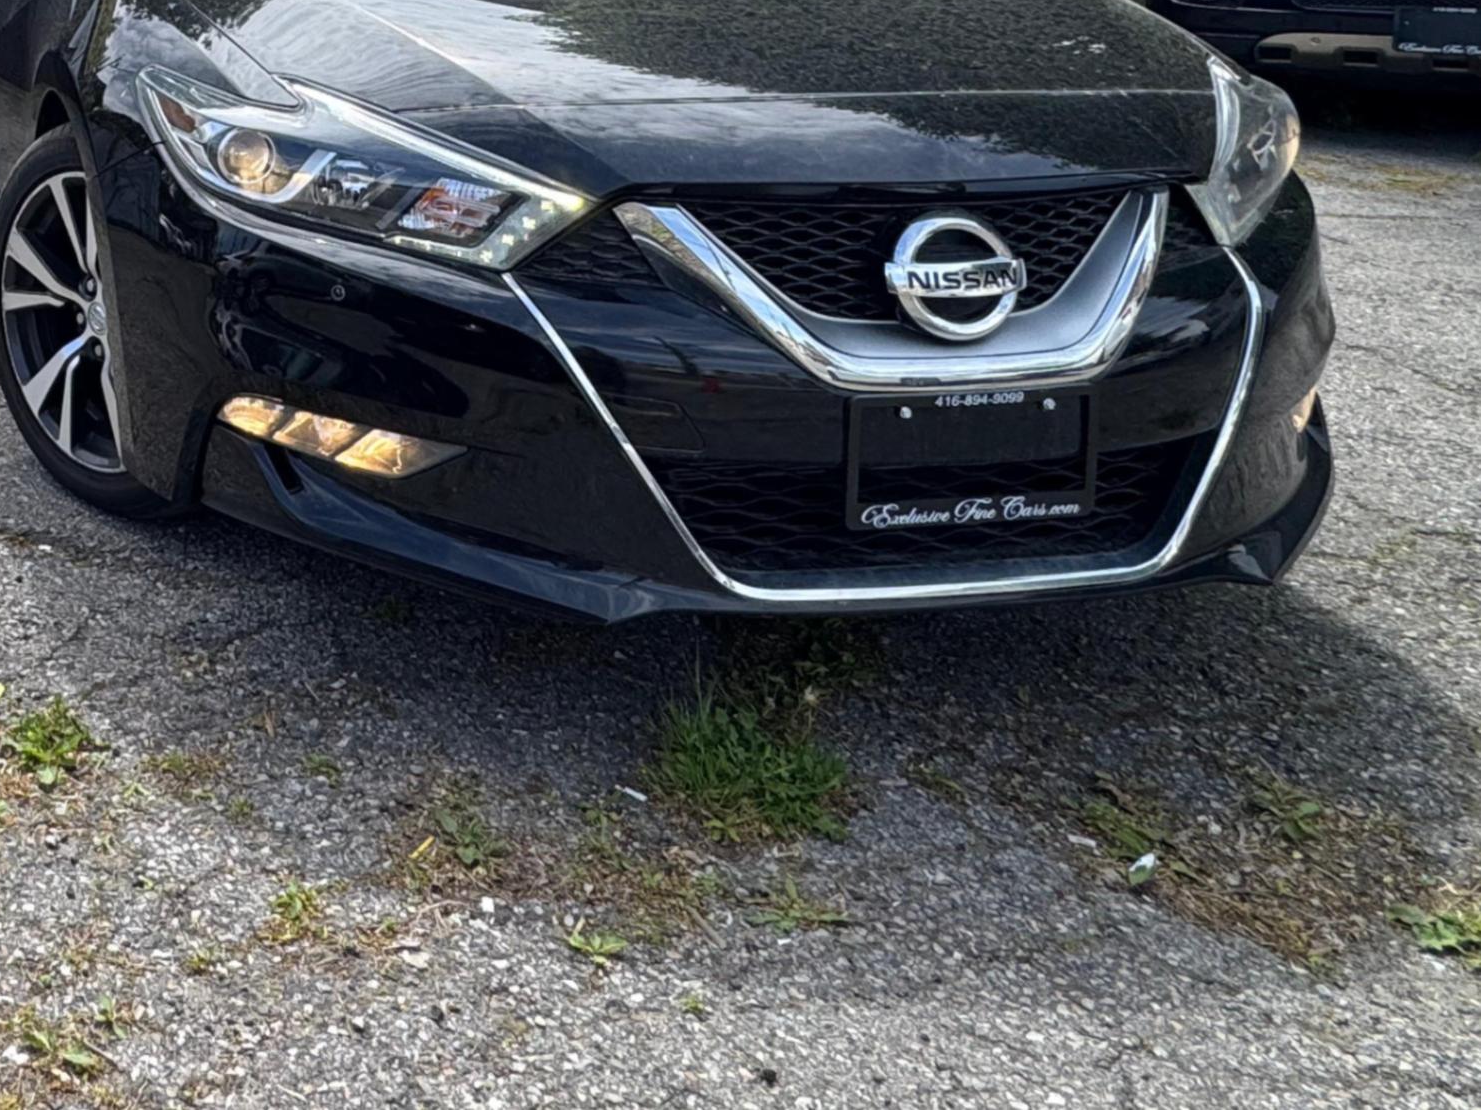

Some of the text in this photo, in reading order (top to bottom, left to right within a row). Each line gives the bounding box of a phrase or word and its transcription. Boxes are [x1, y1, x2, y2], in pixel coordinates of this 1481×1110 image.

[907, 268, 1017, 290] NISSAN
[935, 391, 1024, 407] 416-894-9099
[861, 503, 951, 528] Exclusive
[953, 498, 997, 522] Fine
